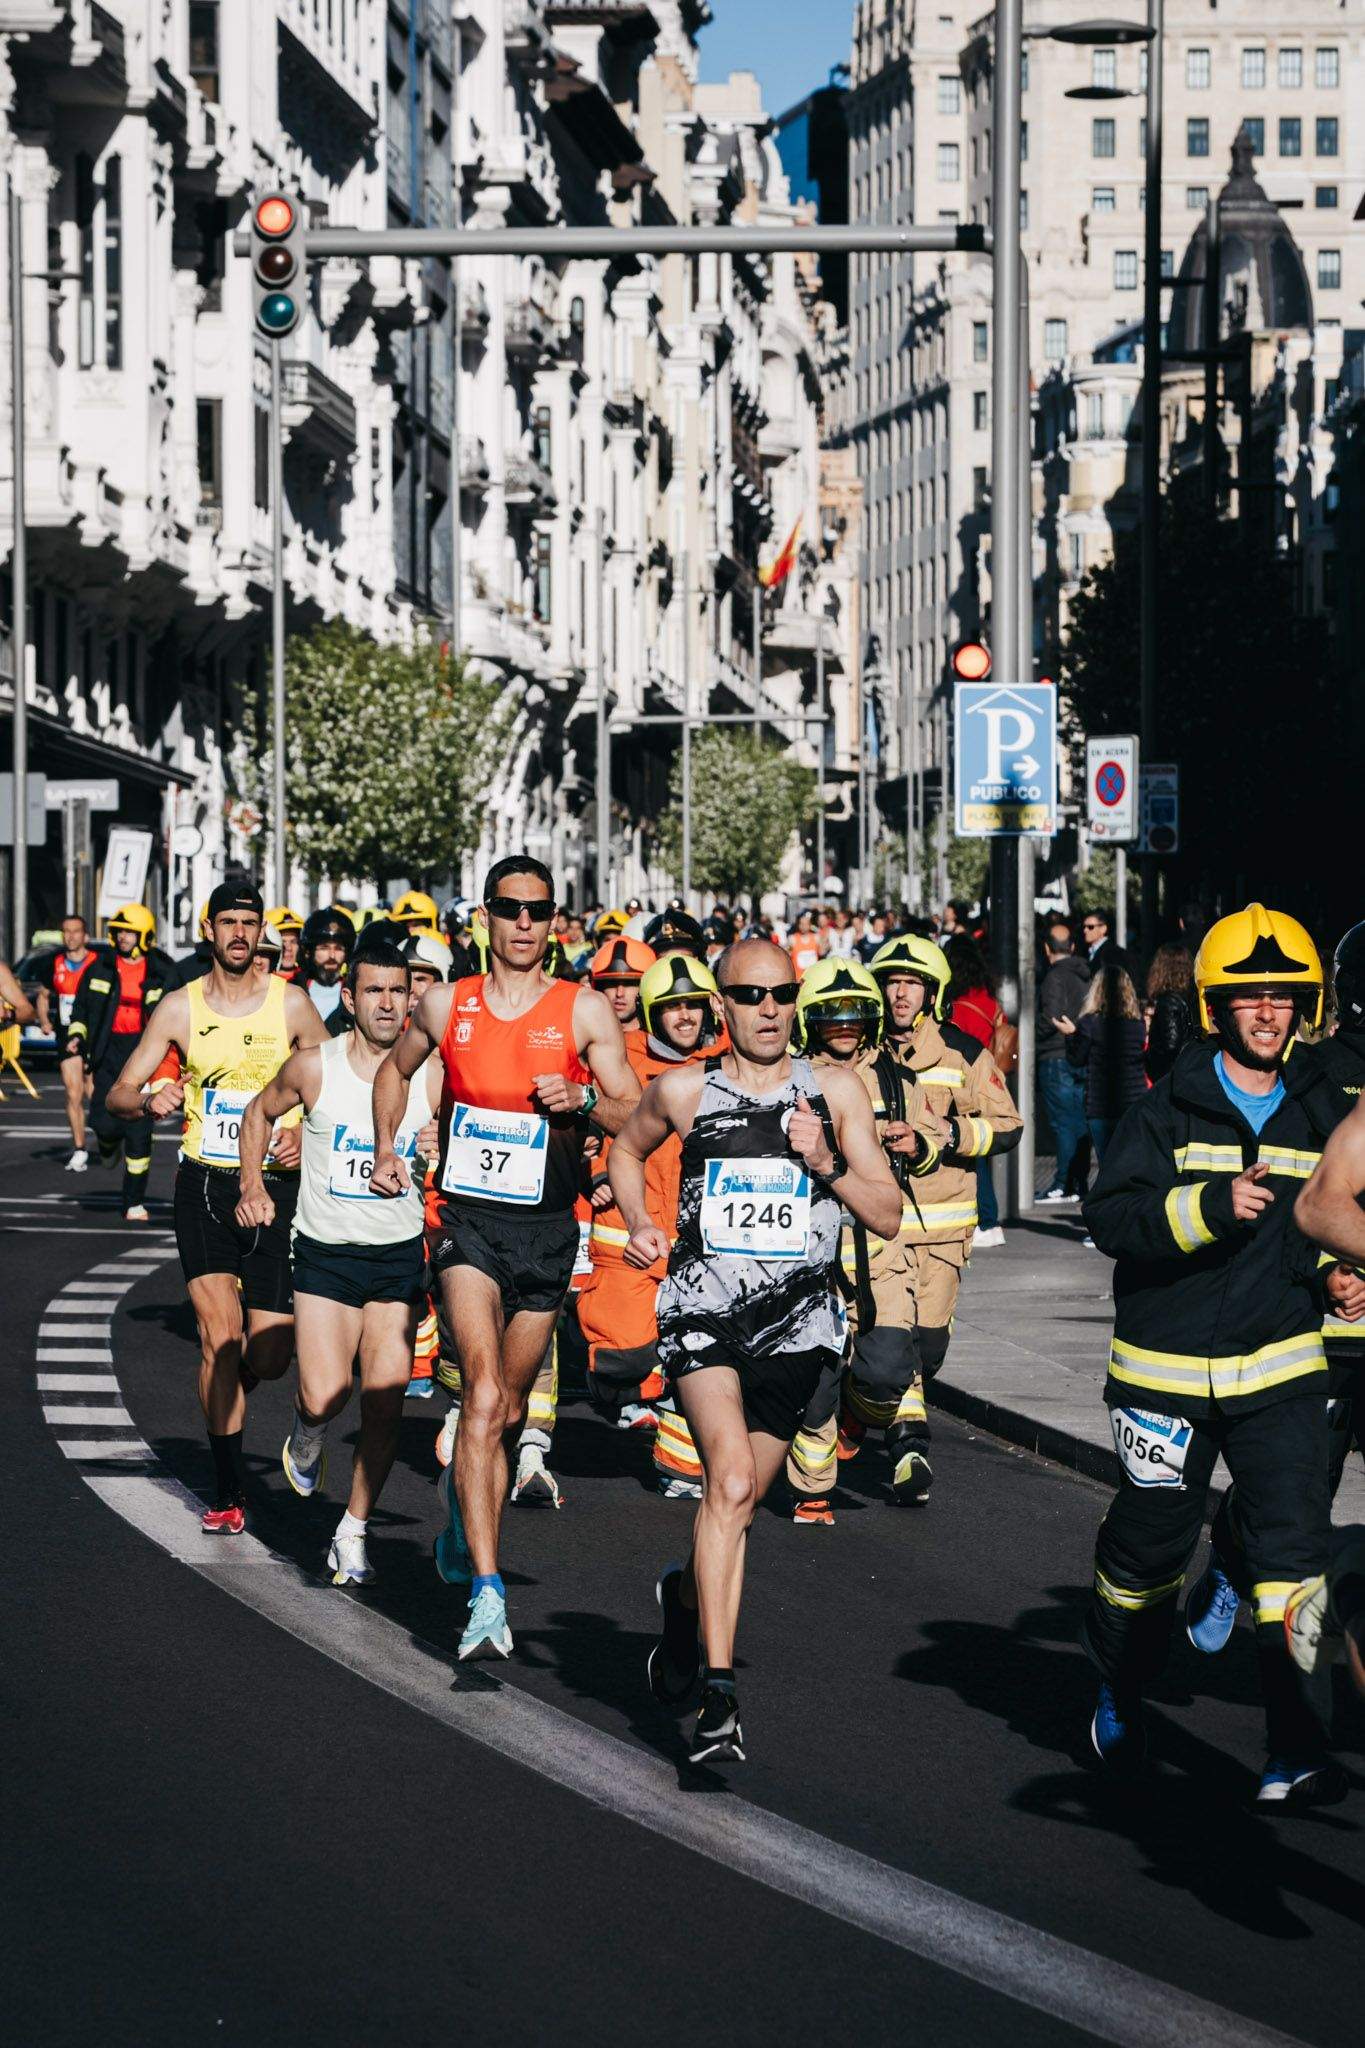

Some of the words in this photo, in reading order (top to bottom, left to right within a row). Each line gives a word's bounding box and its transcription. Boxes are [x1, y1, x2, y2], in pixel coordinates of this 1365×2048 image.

[976, 707, 1036, 785] P
[121, 853, 131, 878] 1
[217, 1120, 240, 1140] 10
[477, 1121, 530, 1136] BOMBEROS
[346, 1158, 374, 1180] 16
[480, 1148, 511, 1174] 37
[737, 1174, 793, 1185] BOMBEROS
[722, 1202, 793, 1229] 1246
[1115, 1417, 1166, 1464] 1056
